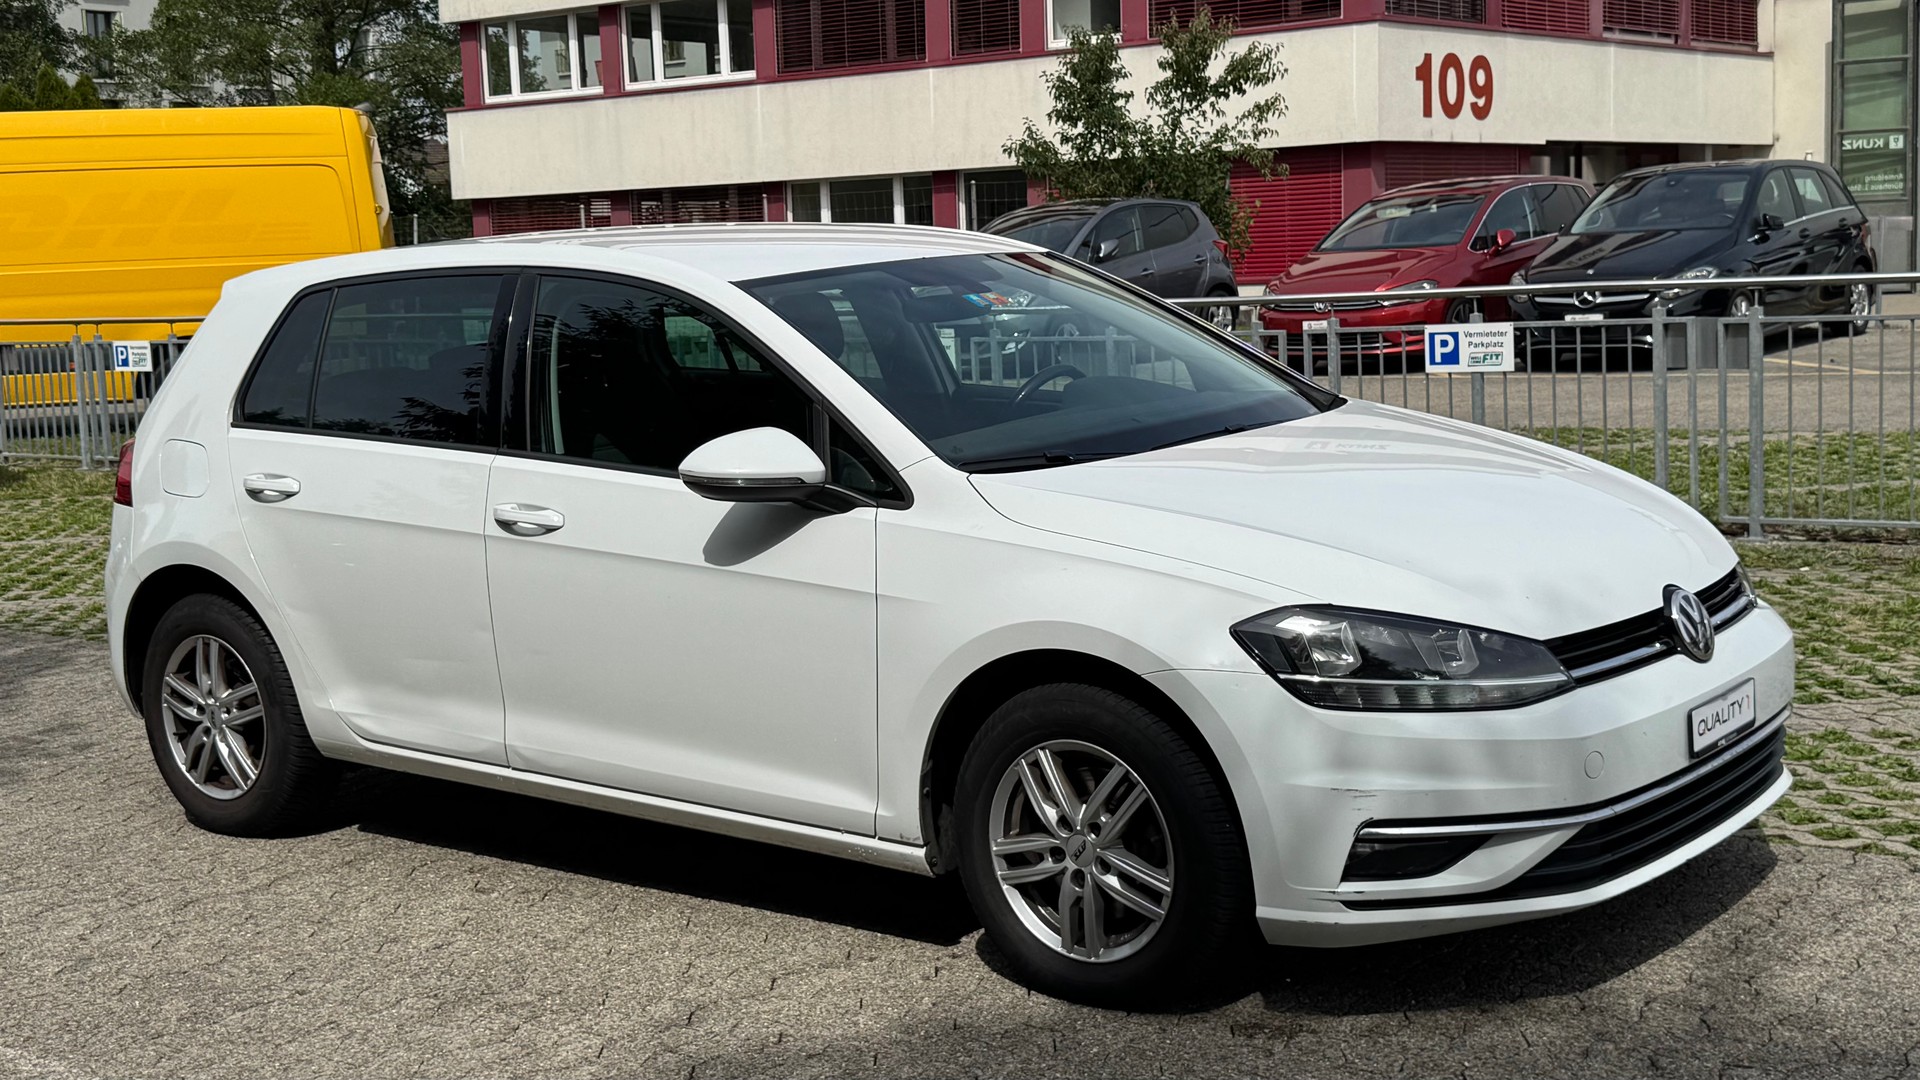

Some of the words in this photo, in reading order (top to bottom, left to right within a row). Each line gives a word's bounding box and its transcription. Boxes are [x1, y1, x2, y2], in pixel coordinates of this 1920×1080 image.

[1415, 52, 1493, 121] 109
[117, 346, 127, 366] P
[1434, 334, 1455, 363] P
[1468, 341, 1504, 349] Parkplatz
[1482, 353, 1501, 363] FIT
[1698, 696, 1744, 736] QUALITY
